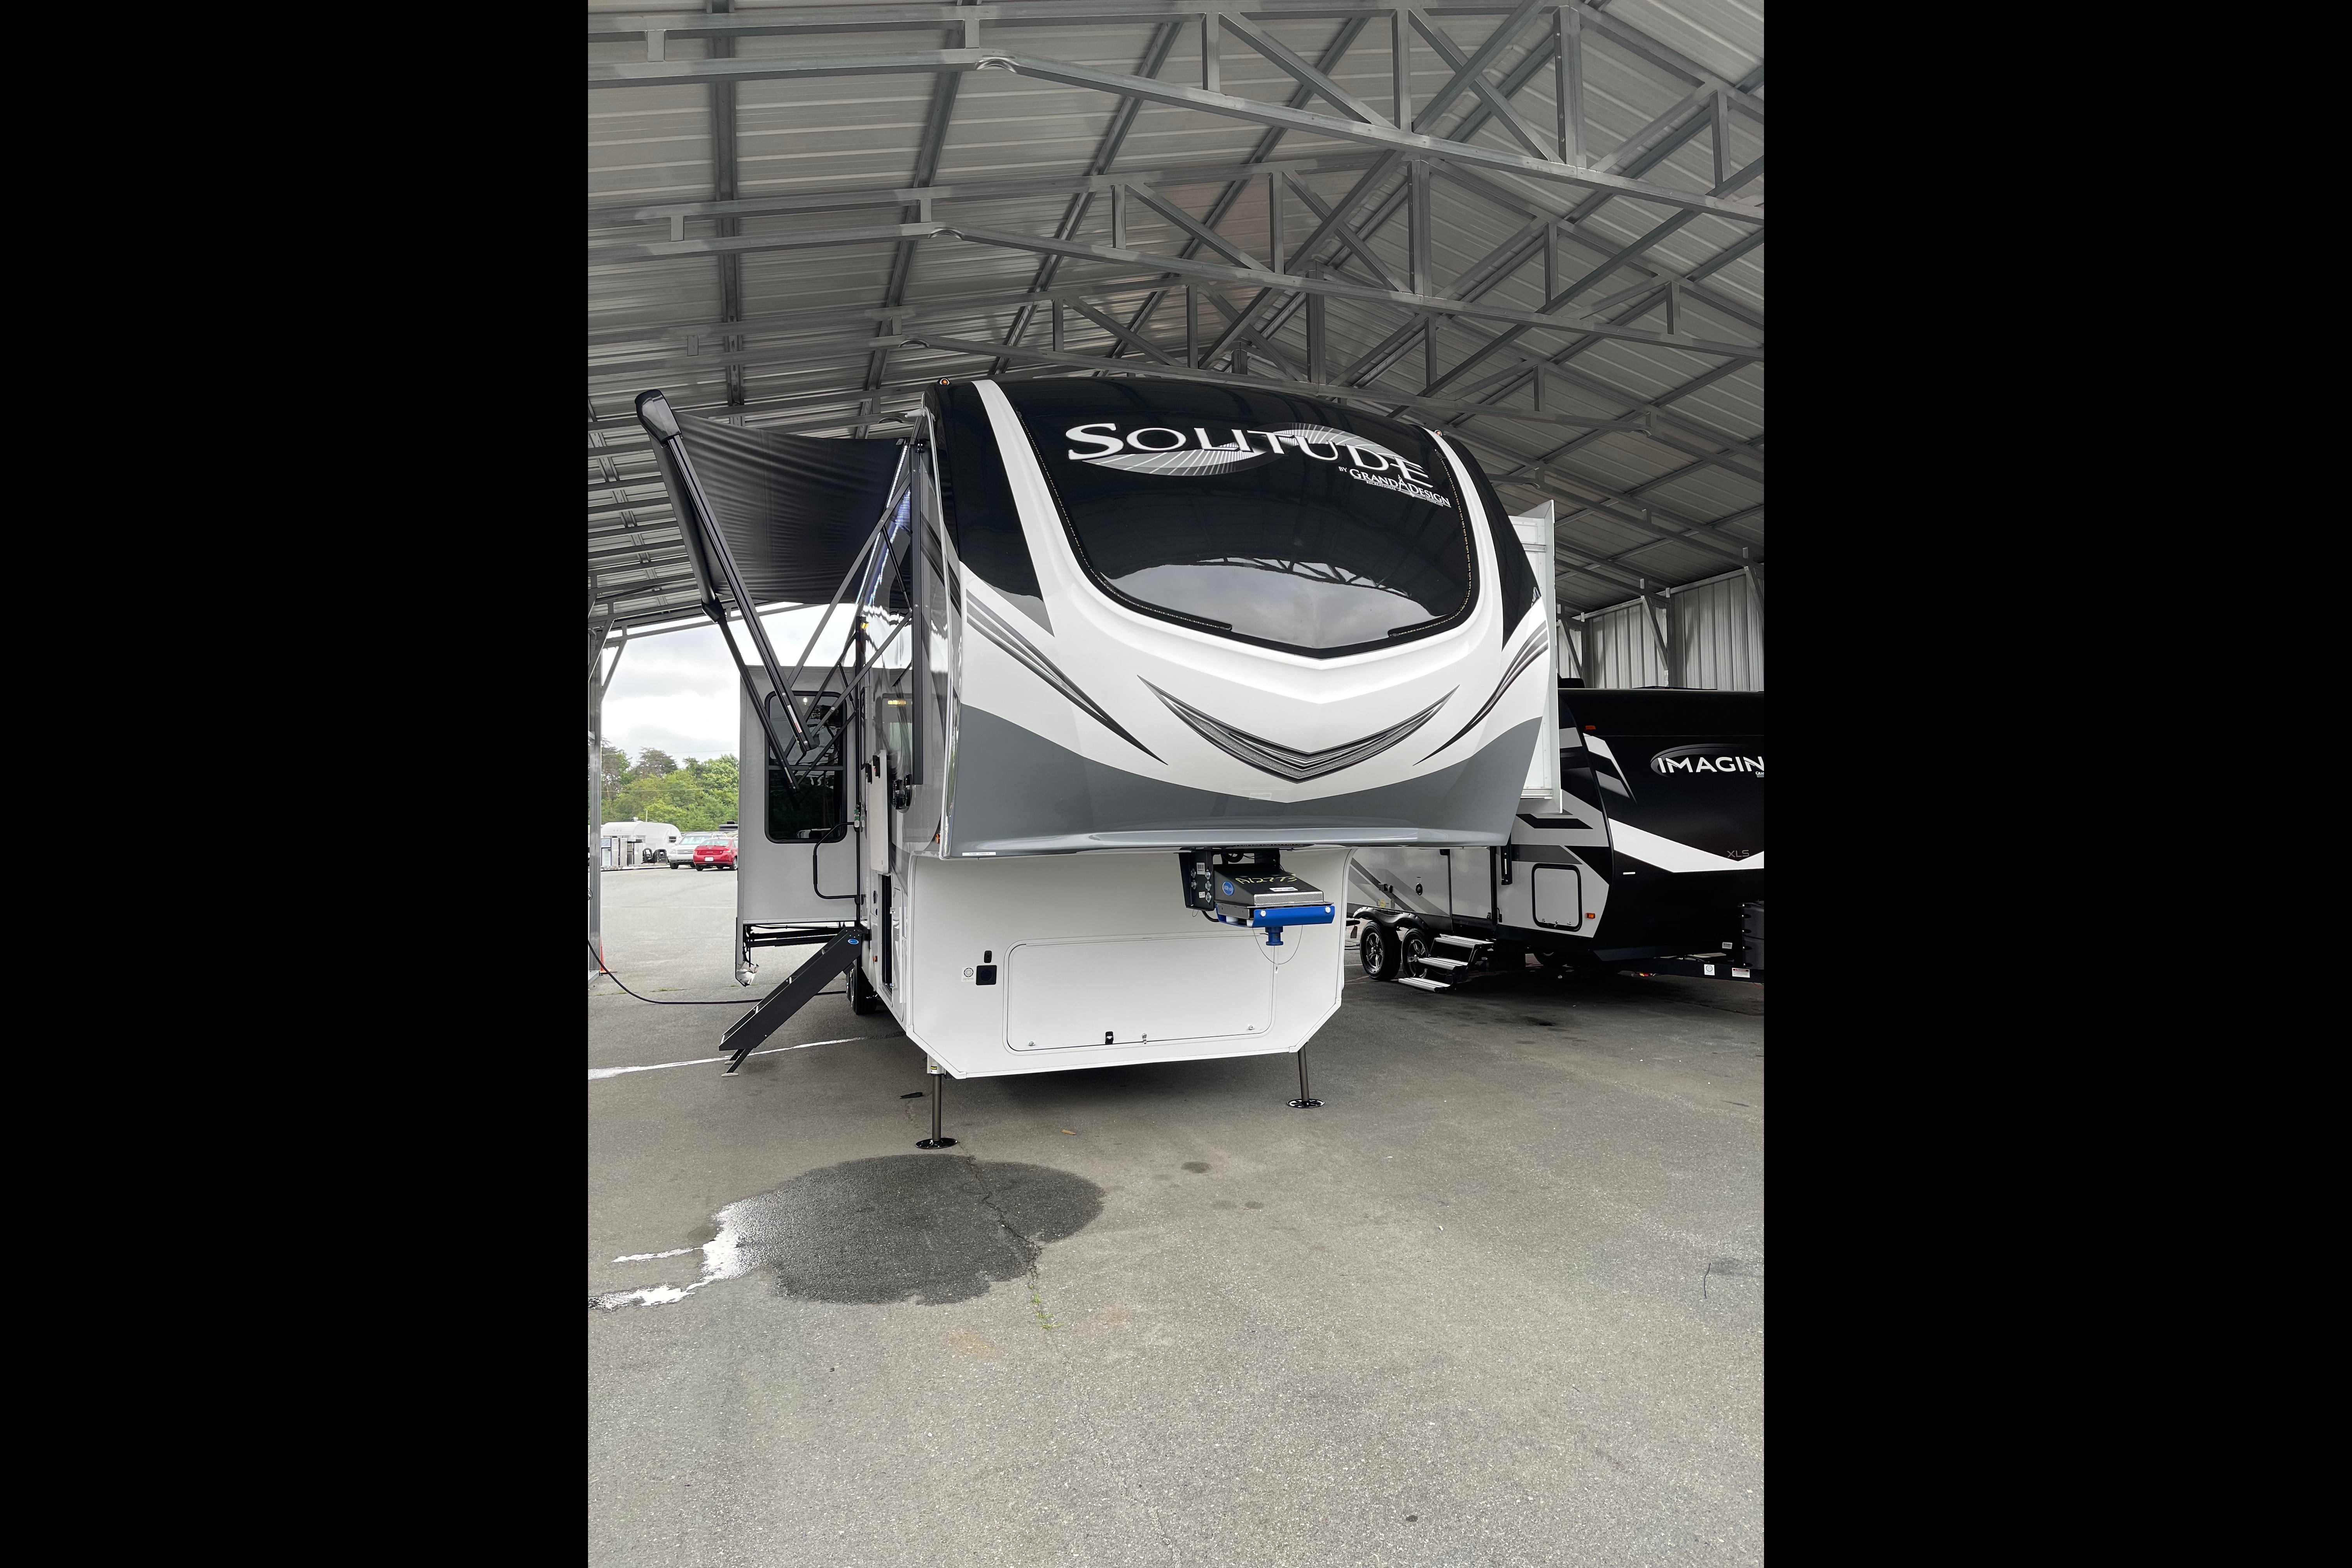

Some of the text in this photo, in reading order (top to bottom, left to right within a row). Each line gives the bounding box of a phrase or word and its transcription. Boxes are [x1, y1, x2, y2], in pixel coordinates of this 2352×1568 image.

[1066, 423, 1433, 488] SOLITUDE
[1349, 469, 1398, 487] GRAND
[1407, 483, 1451, 507] DESIGN
[1366, 481, 1396, 491] RECREATIONAL
[1657, 756, 1764, 773] IMAGIN
[1727, 850, 1750, 858] XLS
